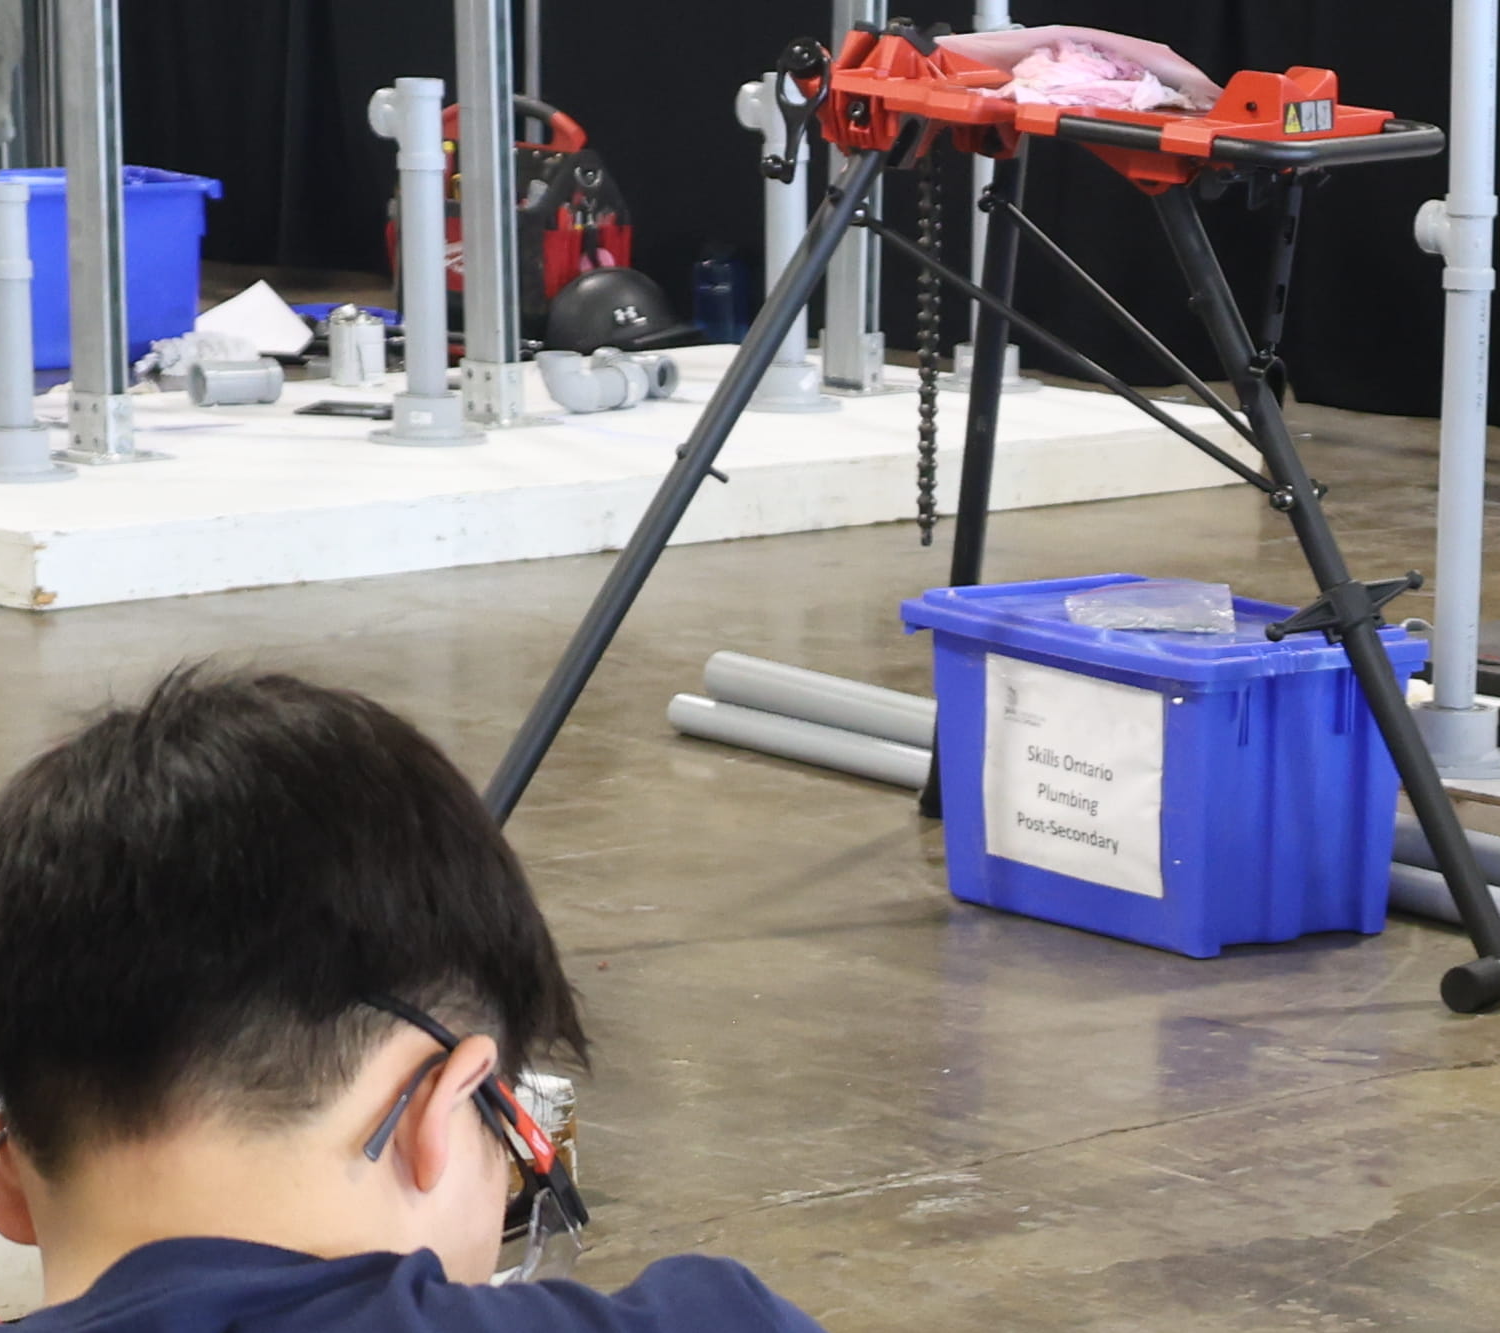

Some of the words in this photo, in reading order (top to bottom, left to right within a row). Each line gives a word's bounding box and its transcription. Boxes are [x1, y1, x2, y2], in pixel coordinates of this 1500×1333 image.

[1027, 745, 1061, 769] Skills
[1063, 754, 1114, 782] Ontario
[1037, 782, 1100, 817] Plumbing
[1016, 811, 1120, 856] Post-Secondary
